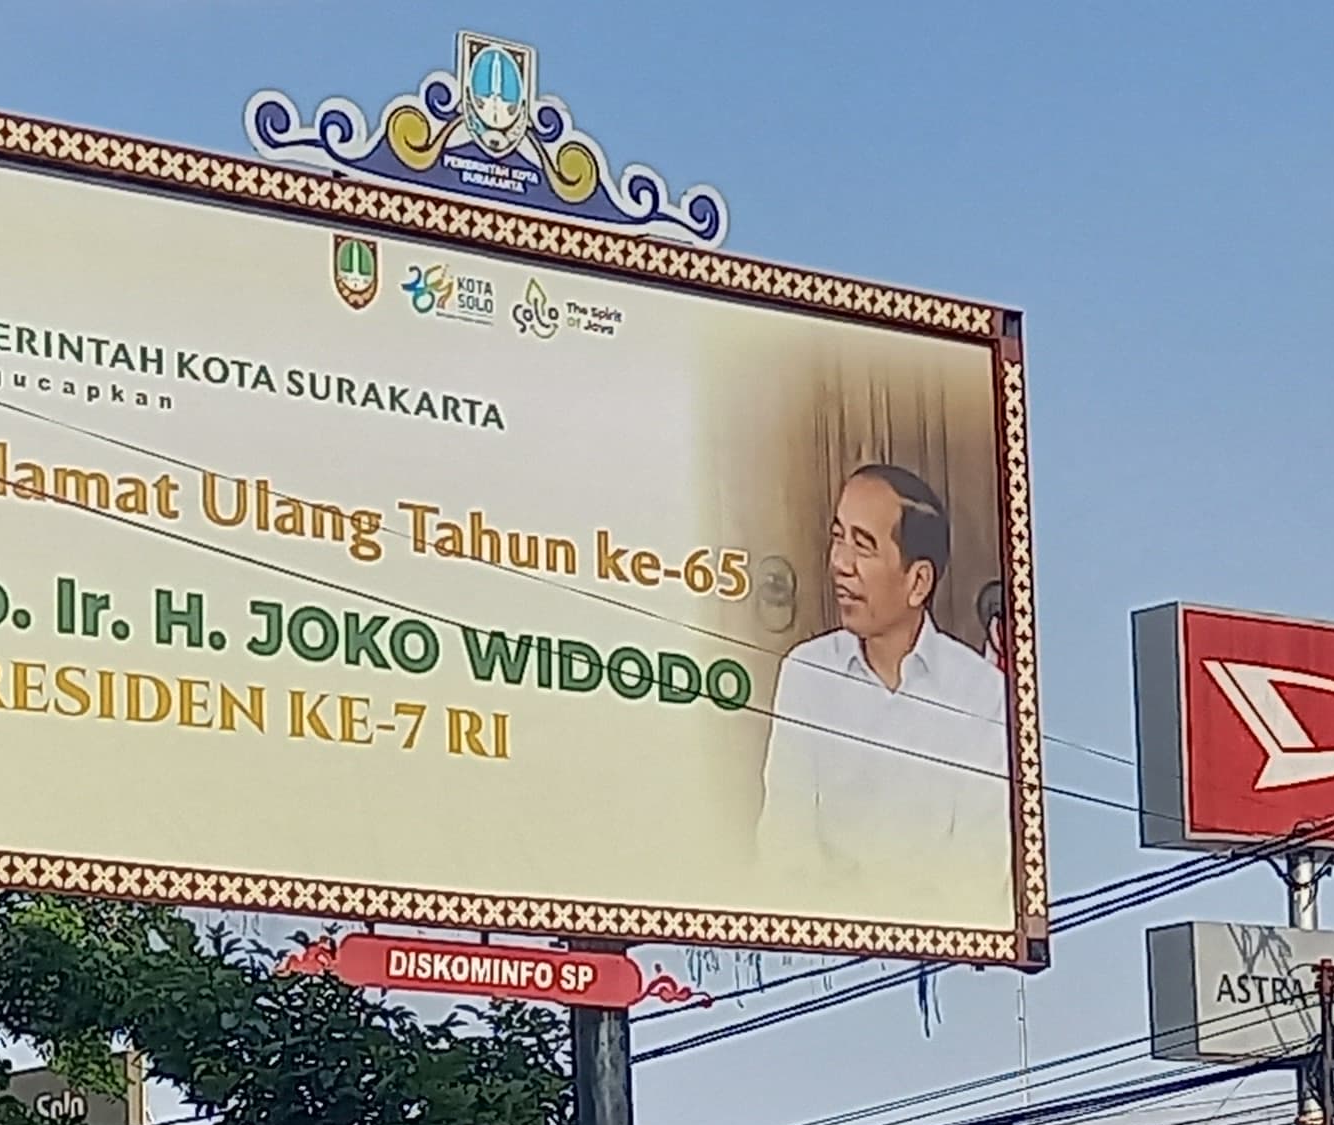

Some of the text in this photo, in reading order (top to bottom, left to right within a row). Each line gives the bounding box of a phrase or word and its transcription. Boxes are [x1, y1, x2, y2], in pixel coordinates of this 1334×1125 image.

[457, 276, 493, 297] KOTA
[457, 293, 493, 314] SOLO
[566, 301, 588, 315] The
[583, 320, 614, 335] Java
[175, 352, 276, 394] KOTA
[285, 369, 505, 431] SURAKARTA
[201, 470, 383, 562] Ulang
[397, 501, 577, 575] Tahun
[596, 530, 750, 598] ke-65
[56, 577, 130, 640] Ir.
[154, 588, 227, 651] H.
[246, 600, 441, 675] JOKO
[462, 627, 752, 711] WIDODO
[288, 689, 428, 750] KE-7
[445, 706, 511, 759] RI
[388, 950, 594, 992] DISKOMINFO SP
[1216, 973, 1308, 1011] ASTRA
